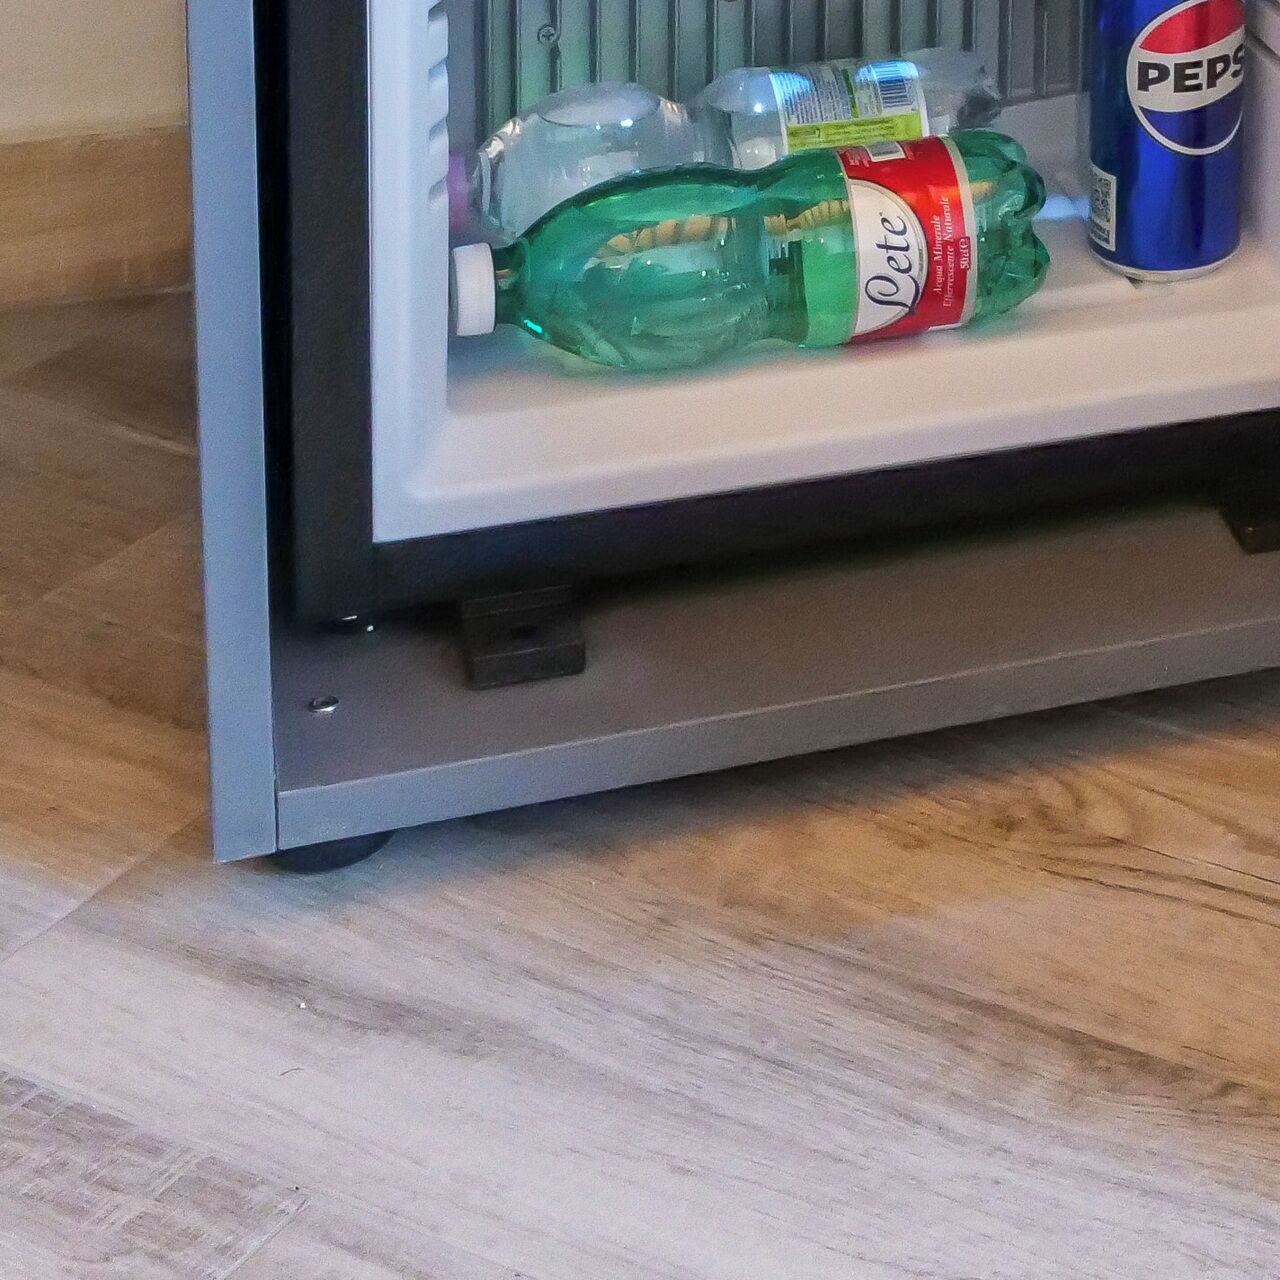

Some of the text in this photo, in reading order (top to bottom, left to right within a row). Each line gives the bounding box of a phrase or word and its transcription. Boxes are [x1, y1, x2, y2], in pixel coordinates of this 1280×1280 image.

[1137, 42, 1245, 93] PEPS
[940, 197, 953, 242] Naturale
[865, 215, 920, 316] Lete
[931, 215, 945, 294] Acqua Minerale
